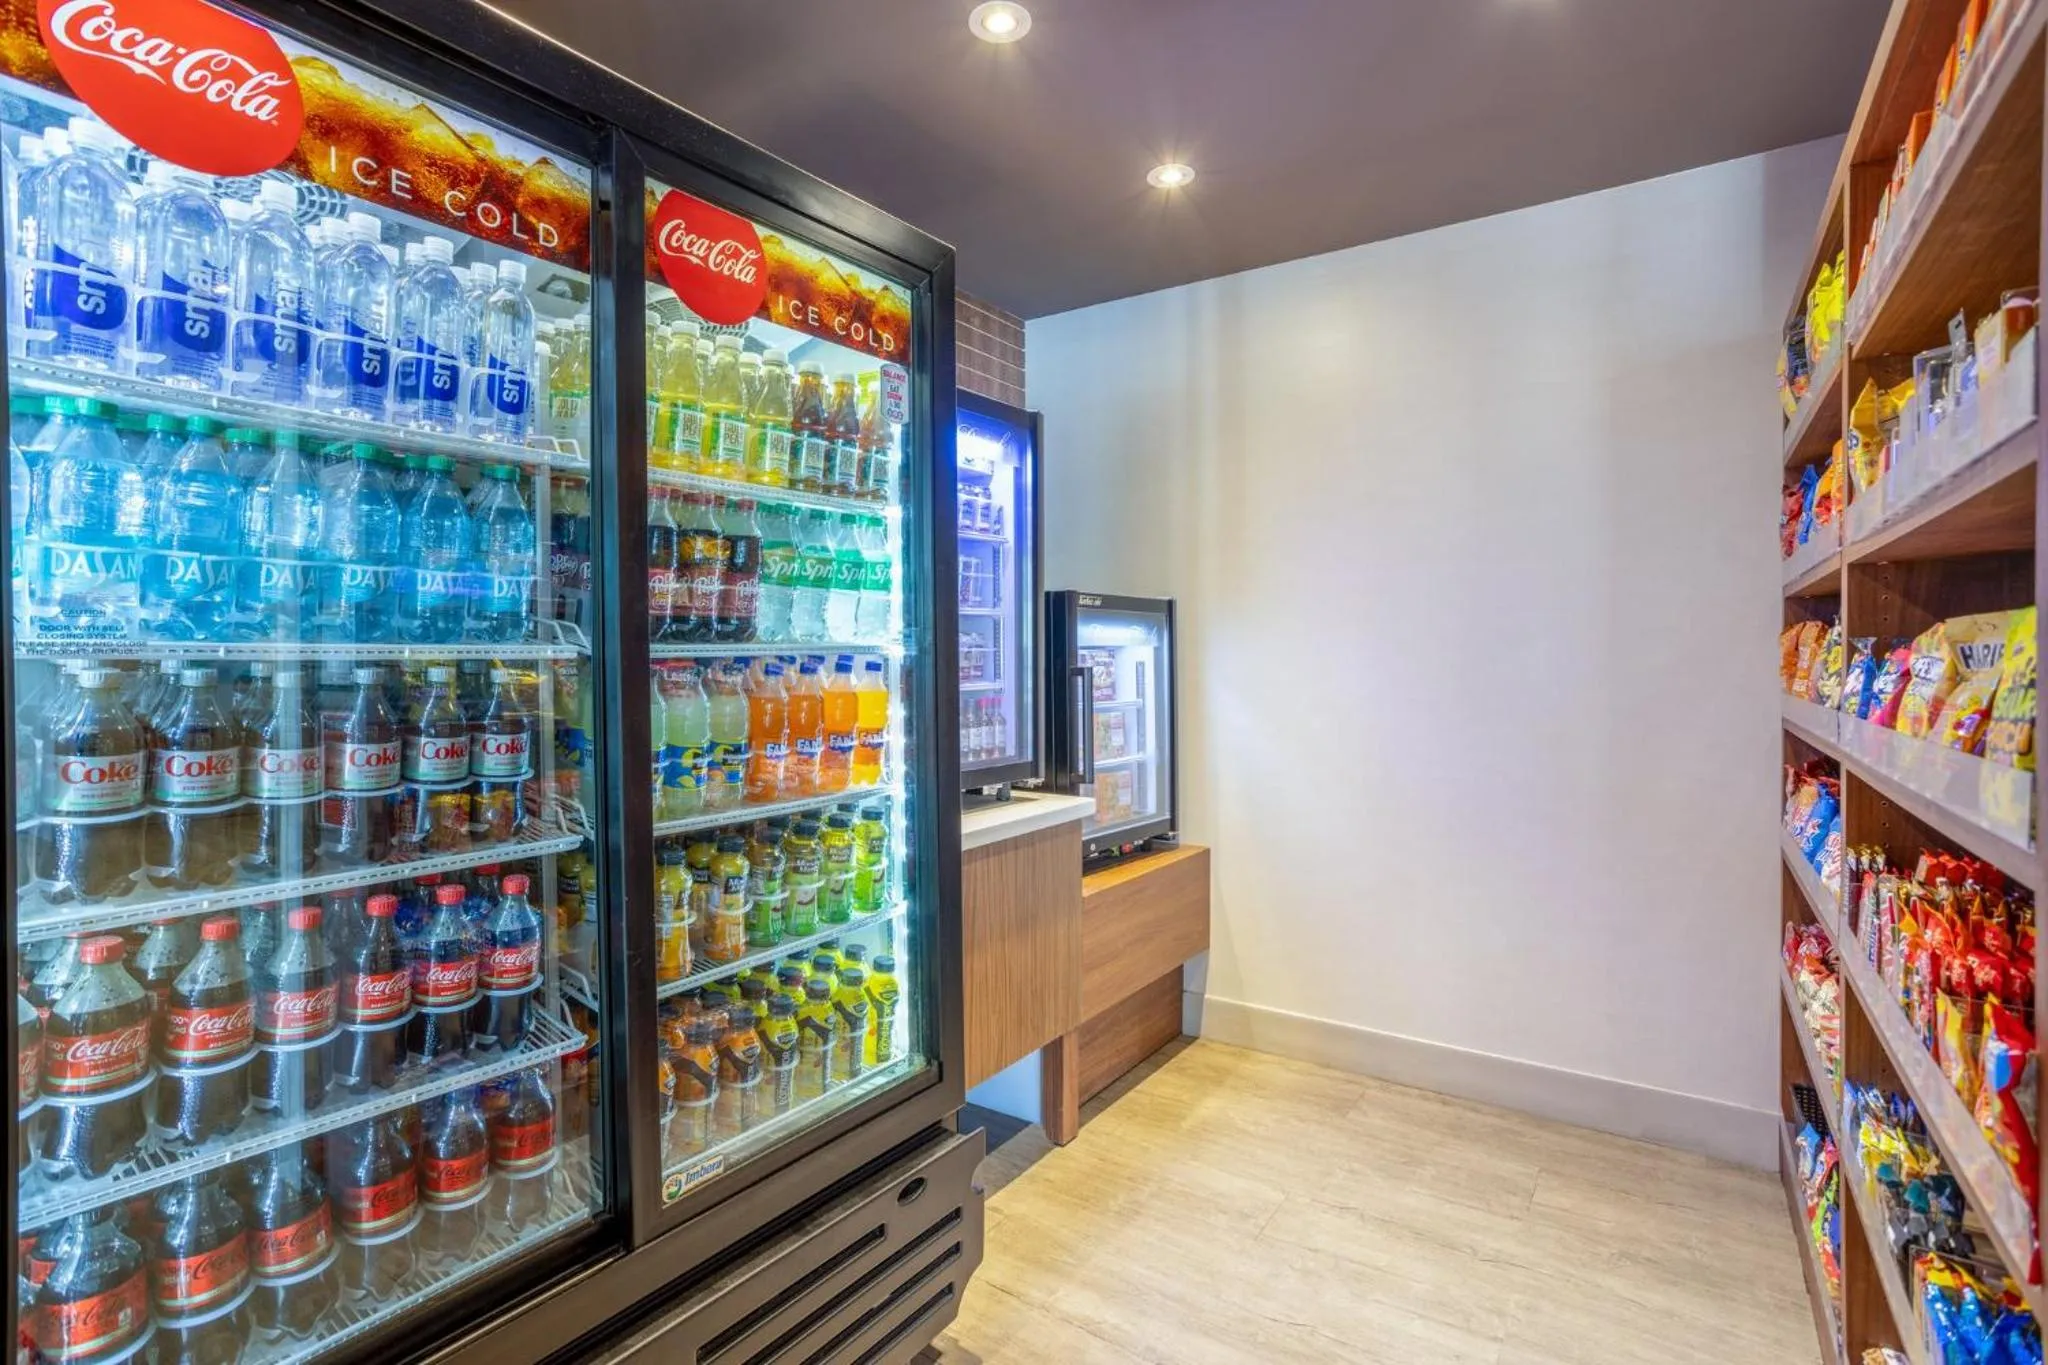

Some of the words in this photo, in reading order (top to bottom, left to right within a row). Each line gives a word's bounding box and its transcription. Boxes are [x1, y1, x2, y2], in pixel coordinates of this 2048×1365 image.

[50, 0, 292, 123] Coca-Cola
[330, 145, 413, 200] ICE
[443, 190, 560, 249] COLD
[658, 218, 761, 284] Coca-Cola
[777, 295, 820, 326] ICE
[834, 317, 895, 351] COLD
[61, 608, 106, 617] CAUTION
[36, 632, 85, 640] CLOSING
[86, 632, 127, 640] SYSTEM
[39, 624, 72, 632] DOOR
[61, 760, 138, 785] Coke
[164, 754, 233, 778] Coke
[685, 1158, 723, 1185] Imbera
